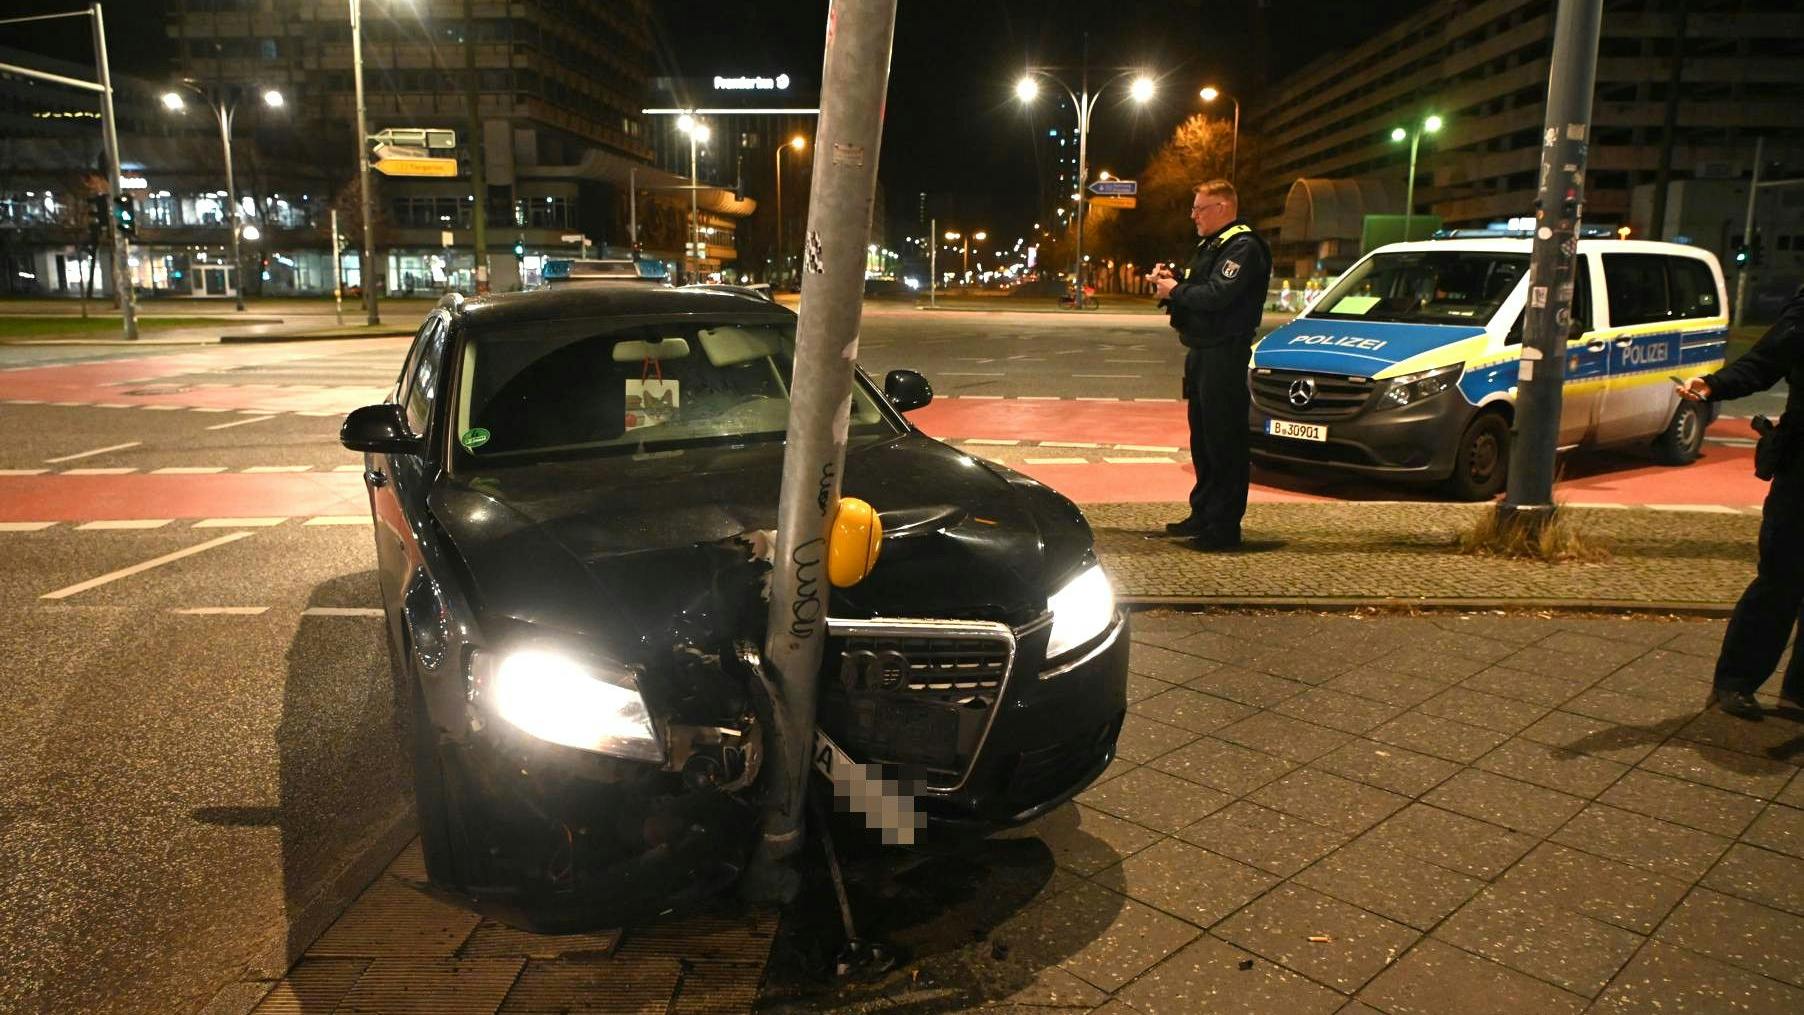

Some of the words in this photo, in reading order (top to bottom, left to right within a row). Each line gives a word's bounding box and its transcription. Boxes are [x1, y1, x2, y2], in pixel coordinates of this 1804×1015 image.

[1288, 335, 1388, 351] POLIZEI
[1622, 342, 1669, 367] POLIZEI
[1287, 424, 1320, 439] 30901
